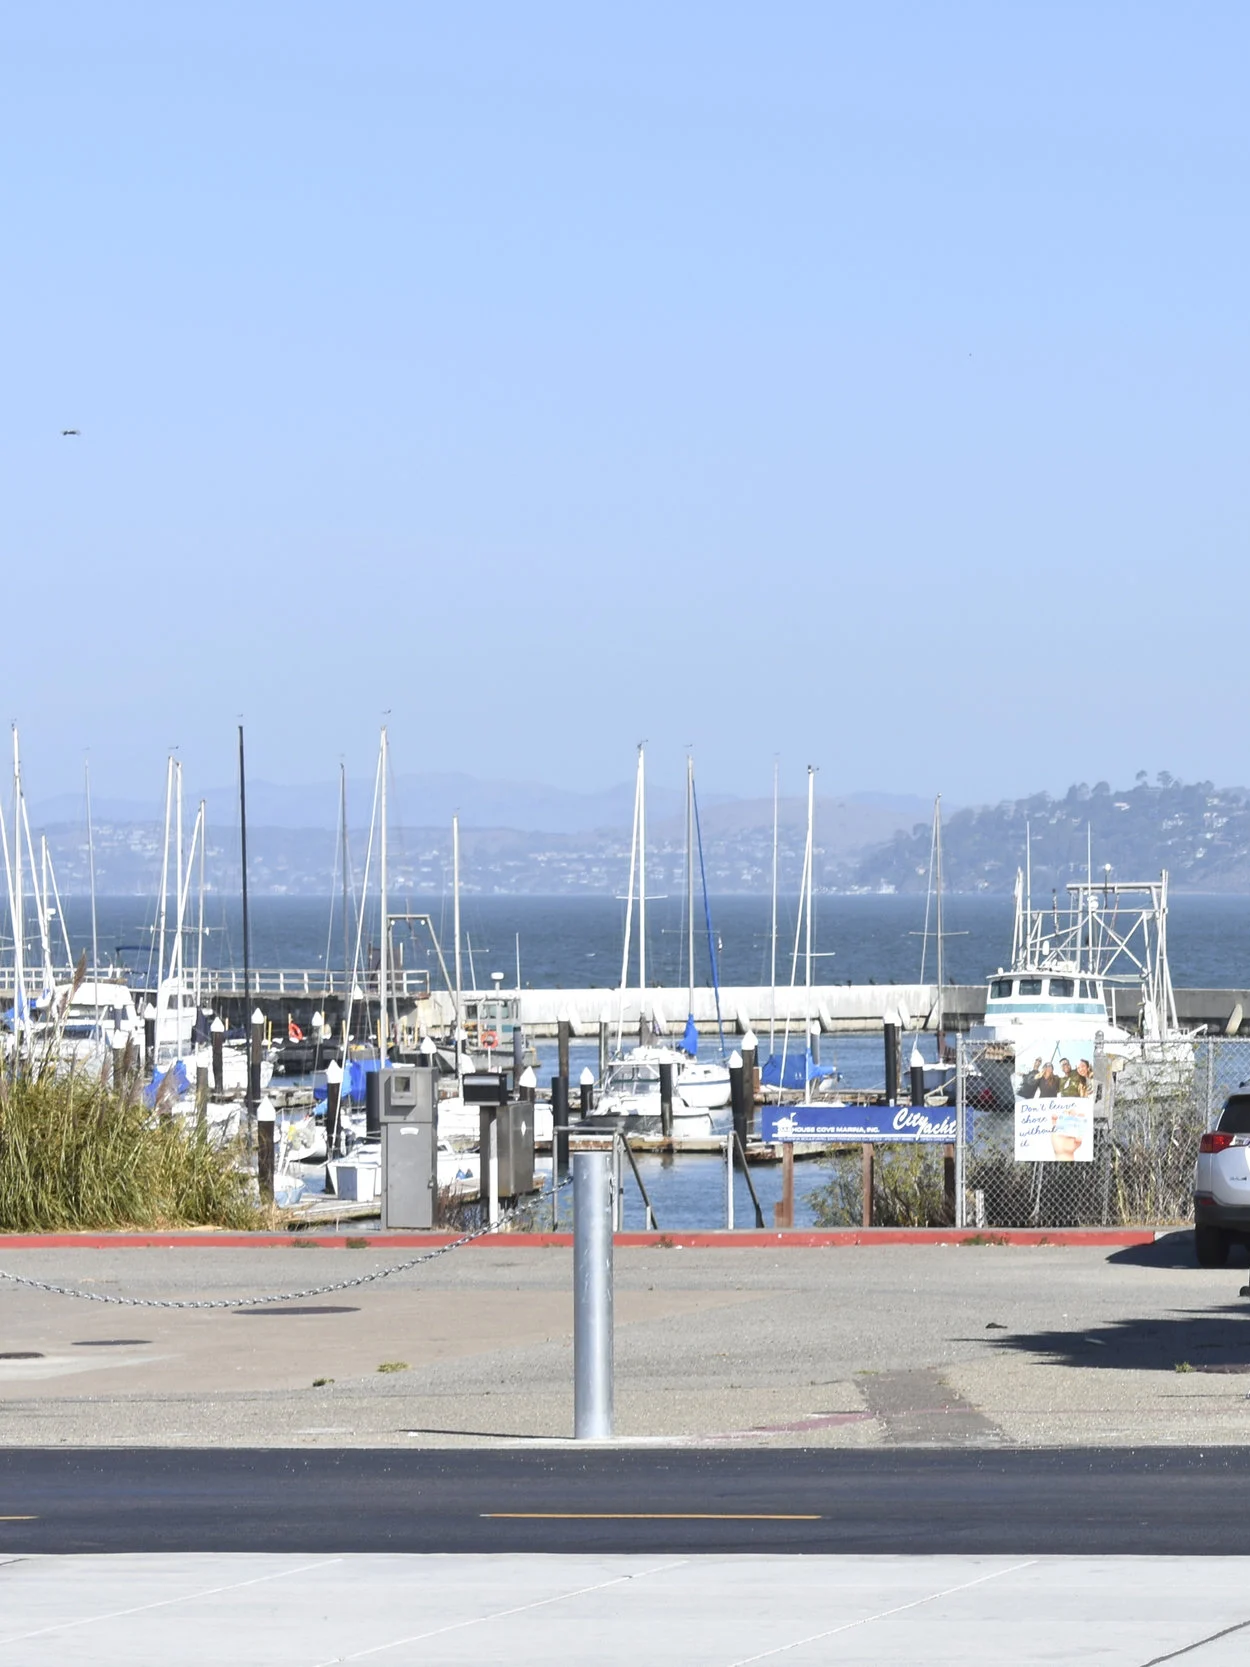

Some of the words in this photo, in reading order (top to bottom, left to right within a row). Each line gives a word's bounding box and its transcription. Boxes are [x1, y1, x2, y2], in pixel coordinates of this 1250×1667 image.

[1020, 1103, 1047, 1113] Don't
[892, 1107, 929, 1141] City
[1019, 1125, 1058, 1137] without
